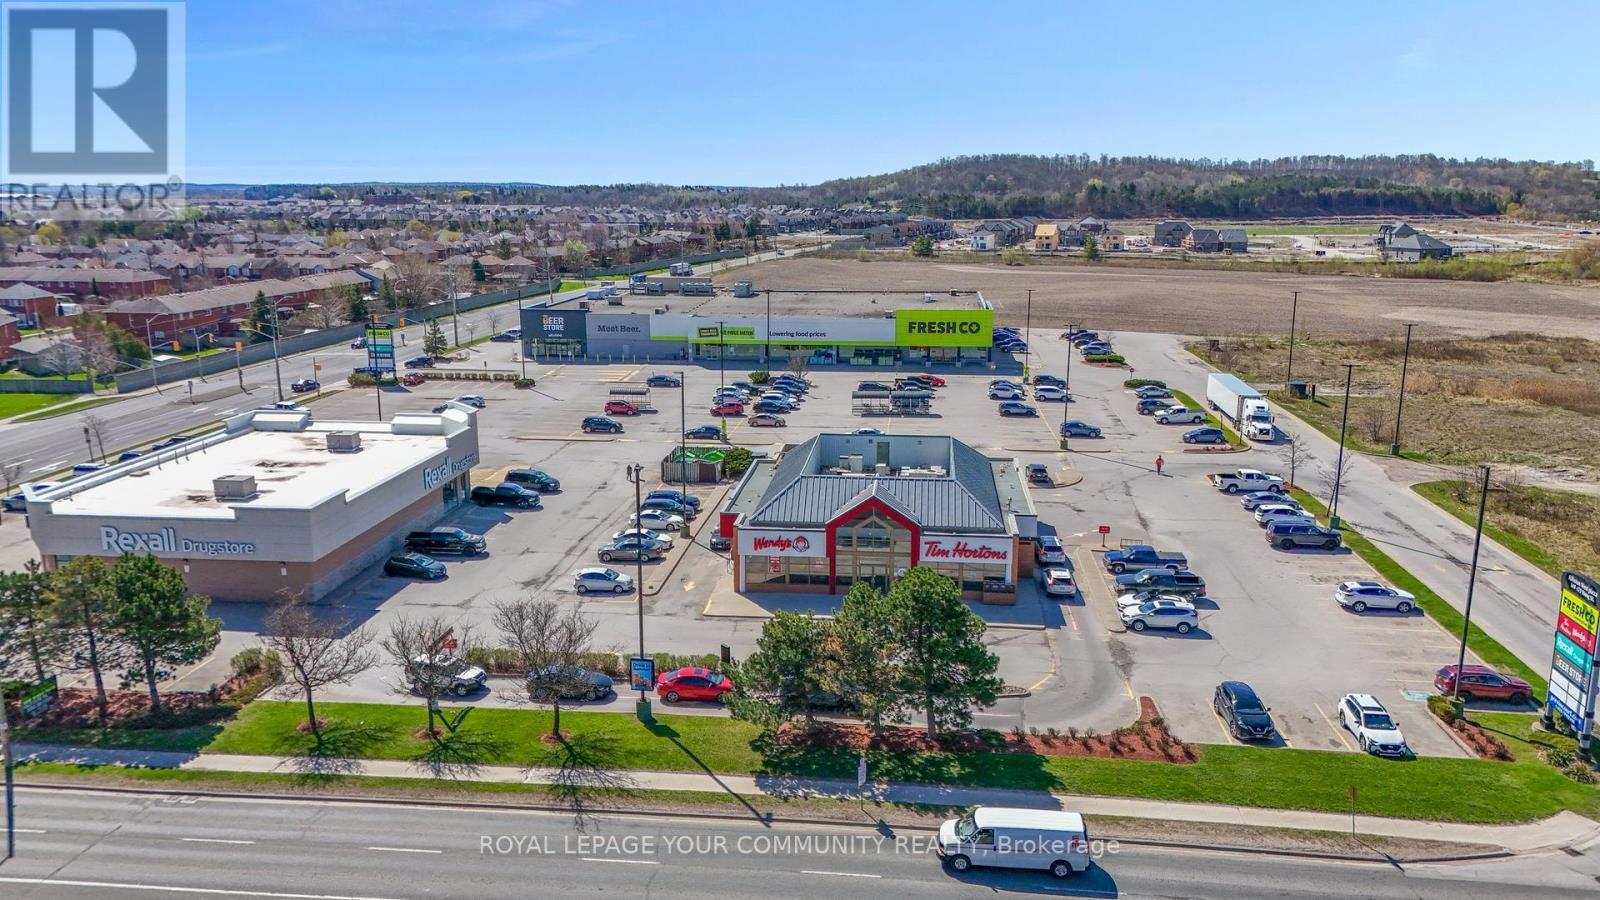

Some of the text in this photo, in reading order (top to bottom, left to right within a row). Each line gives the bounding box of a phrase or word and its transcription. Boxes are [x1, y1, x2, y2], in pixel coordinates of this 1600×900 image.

[543, 316, 564, 324] BEER
[908, 321, 980, 334] FRESH CO
[620, 325, 641, 333] Beer.
[423, 456, 452, 490] Rexall
[100, 525, 255, 556] Rexall Drugstore
[753, 535, 792, 551] Wendy's
[924, 541, 1008, 560] Tim Hortons
[1563, 596, 1584, 619] FRESH
[1584, 610, 1595, 625] CO
